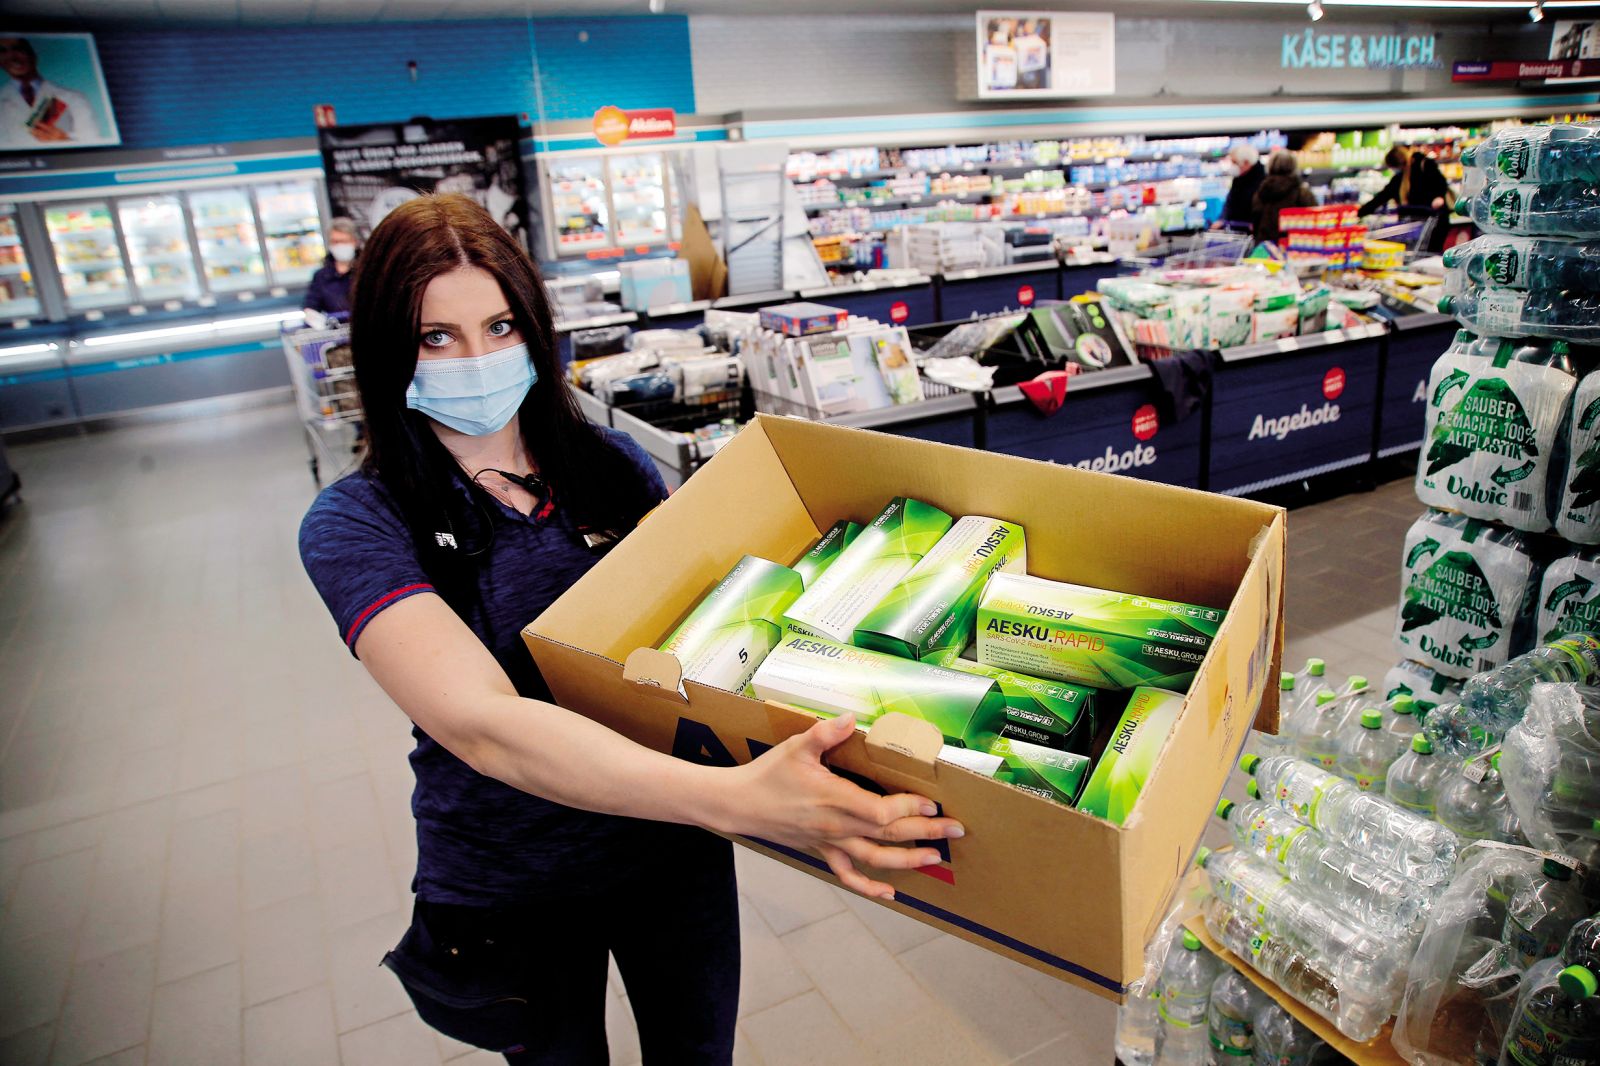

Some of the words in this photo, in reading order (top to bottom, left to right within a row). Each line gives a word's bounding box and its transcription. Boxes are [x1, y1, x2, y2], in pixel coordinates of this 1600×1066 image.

[1281, 27, 1346, 68] KÄSE
[1349, 34, 1367, 67] &
[1368, 34, 1436, 66] MILCH
[1501, 191, 1516, 228] Volvic
[1248, 401, 1341, 441] Angebote
[1464, 395, 1517, 420] SAUBER
[1437, 411, 1499, 436] GEMACHT:
[1503, 421, 1537, 446] 100%
[1445, 430, 1522, 461] ALTPLASTIK
[1447, 475, 1509, 506] Volvic
[1435, 564, 1482, 592] SAUBER
[1419, 593, 1487, 630] ALTPLASTIK
[986, 617, 1105, 652] AESKU.RAPID
[986, 632, 1026, 646] SARS-CoV-2
[1027, 640, 1047, 651] Rapid
[1049, 644, 1063, 653] Test
[1420, 634, 1474, 669] Volvic
[738, 647, 748, 664] 5
[1154, 645, 1205, 661] AESKU.GROUP
[1113, 693, 1151, 755] AESKU.RAPID
